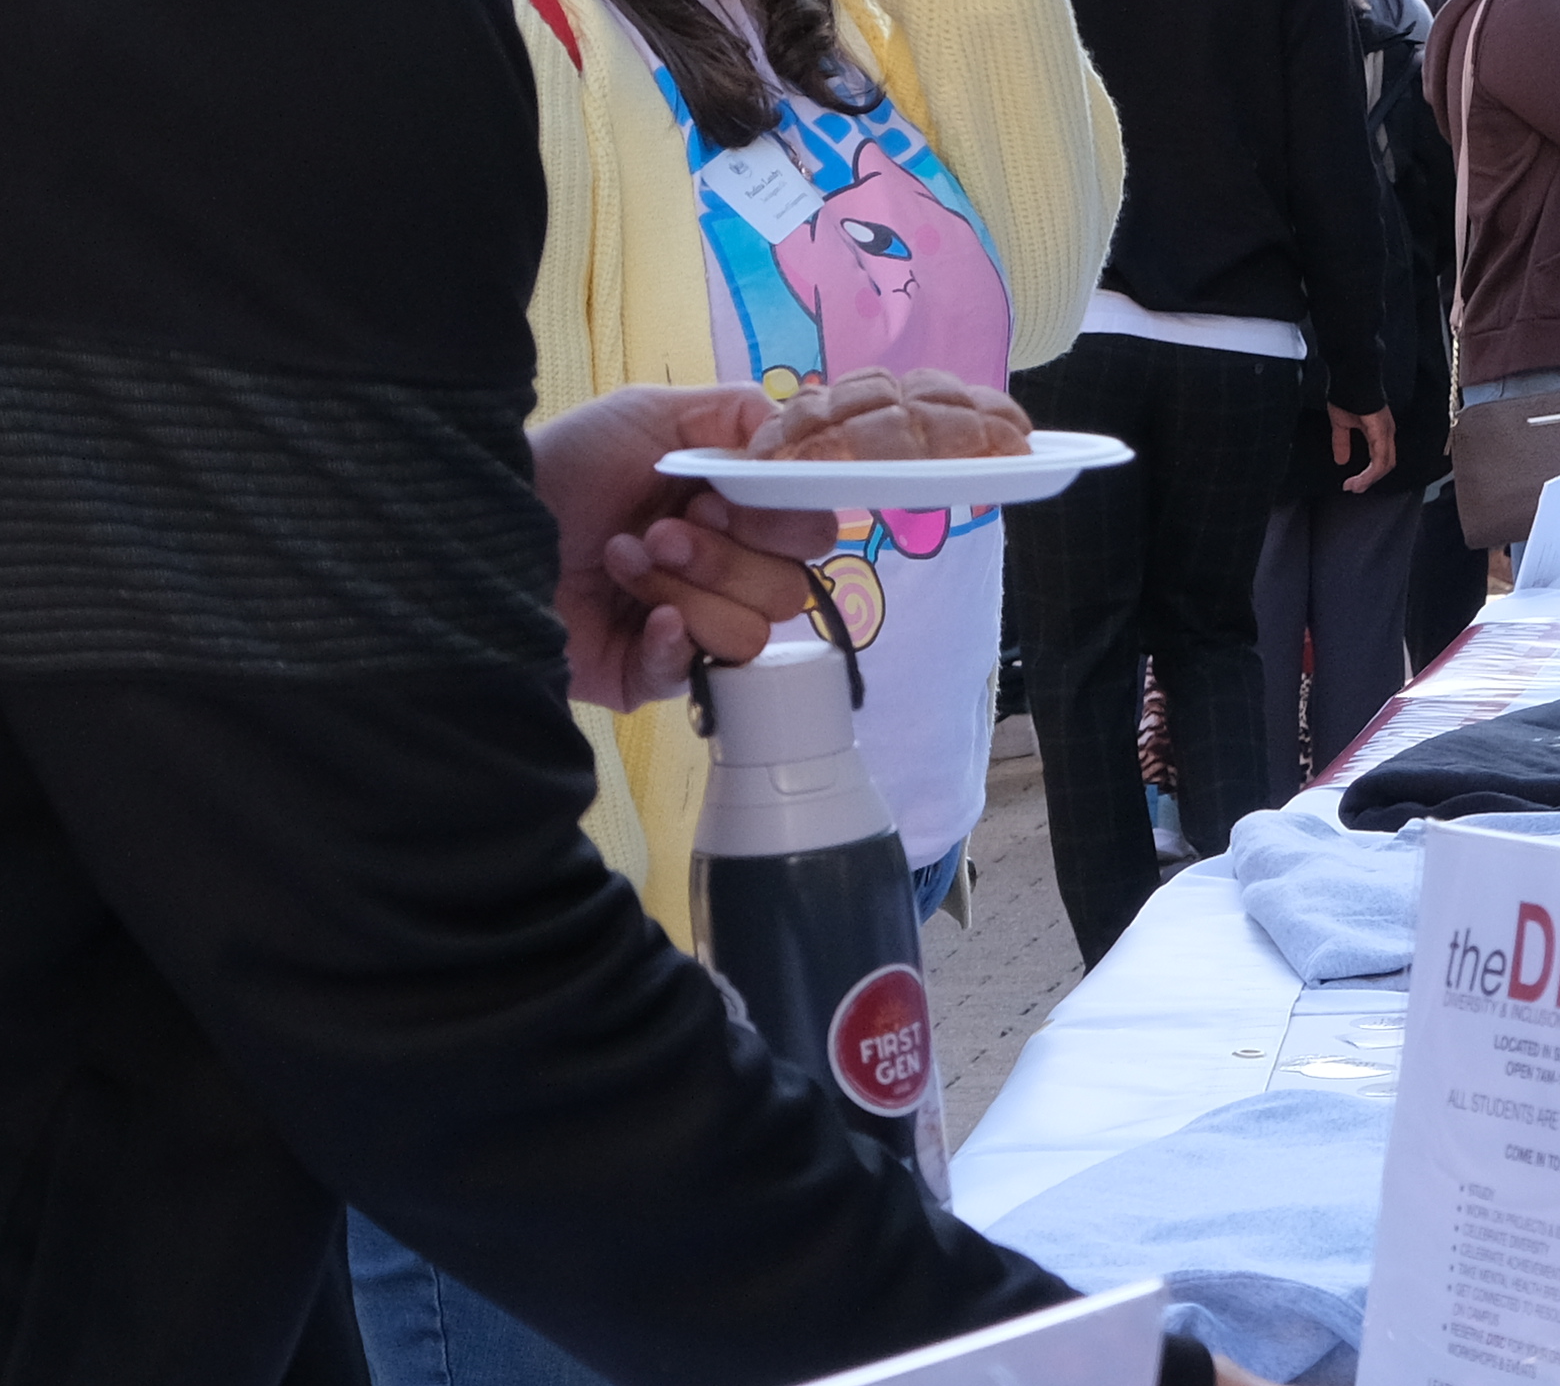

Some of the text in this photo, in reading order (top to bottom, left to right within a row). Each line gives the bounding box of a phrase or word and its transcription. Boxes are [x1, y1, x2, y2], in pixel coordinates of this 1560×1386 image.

[1443, 991, 1496, 1014] DIVERSITY
[1499, 1003, 1507, 1019] &
[860, 1021, 922, 1064] FIRST
[1494, 1034, 1540, 1058] LOCATED
[1542, 1044, 1551, 1058] IN
[875, 1051, 921, 1086] GEN
[1505, 1061, 1534, 1080] OPEN
[1447, 1088, 1468, 1110] ALL
[1472, 1092, 1535, 1125] STUDENTS
[1536, 1108, 1560, 1131] ARE
[1505, 1143, 1534, 1165] COME
[1536, 1152, 1546, 1167] IN
[1466, 1203, 1490, 1220] WORK
[1491, 1210, 1504, 1224] ON
[1506, 1212, 1547, 1236] PROJECTS
[1459, 1242, 1505, 1267] CELEBRATE
[1462, 1222, 1551, 1256] CELEBRATE DIVERSITY
[1458, 1262, 1477, 1281] TAKE
[1479, 1268, 1508, 1289] MENTAL
[1511, 1277, 1542, 1296] HEALTH
[1452, 1302, 1500, 1327] ON CAMPUS
[1455, 1282, 1472, 1298] GET
[1472, 1286, 1521, 1313] CONNECTED
[1523, 1300, 1535, 1316] TO
[1450, 1321, 1485, 1343] RESERVE
[1486, 1332, 1506, 1349] DISC
[1508, 1337, 1525, 1354] FOR
[1447, 1342, 1498, 1369] WORKSHOPS
